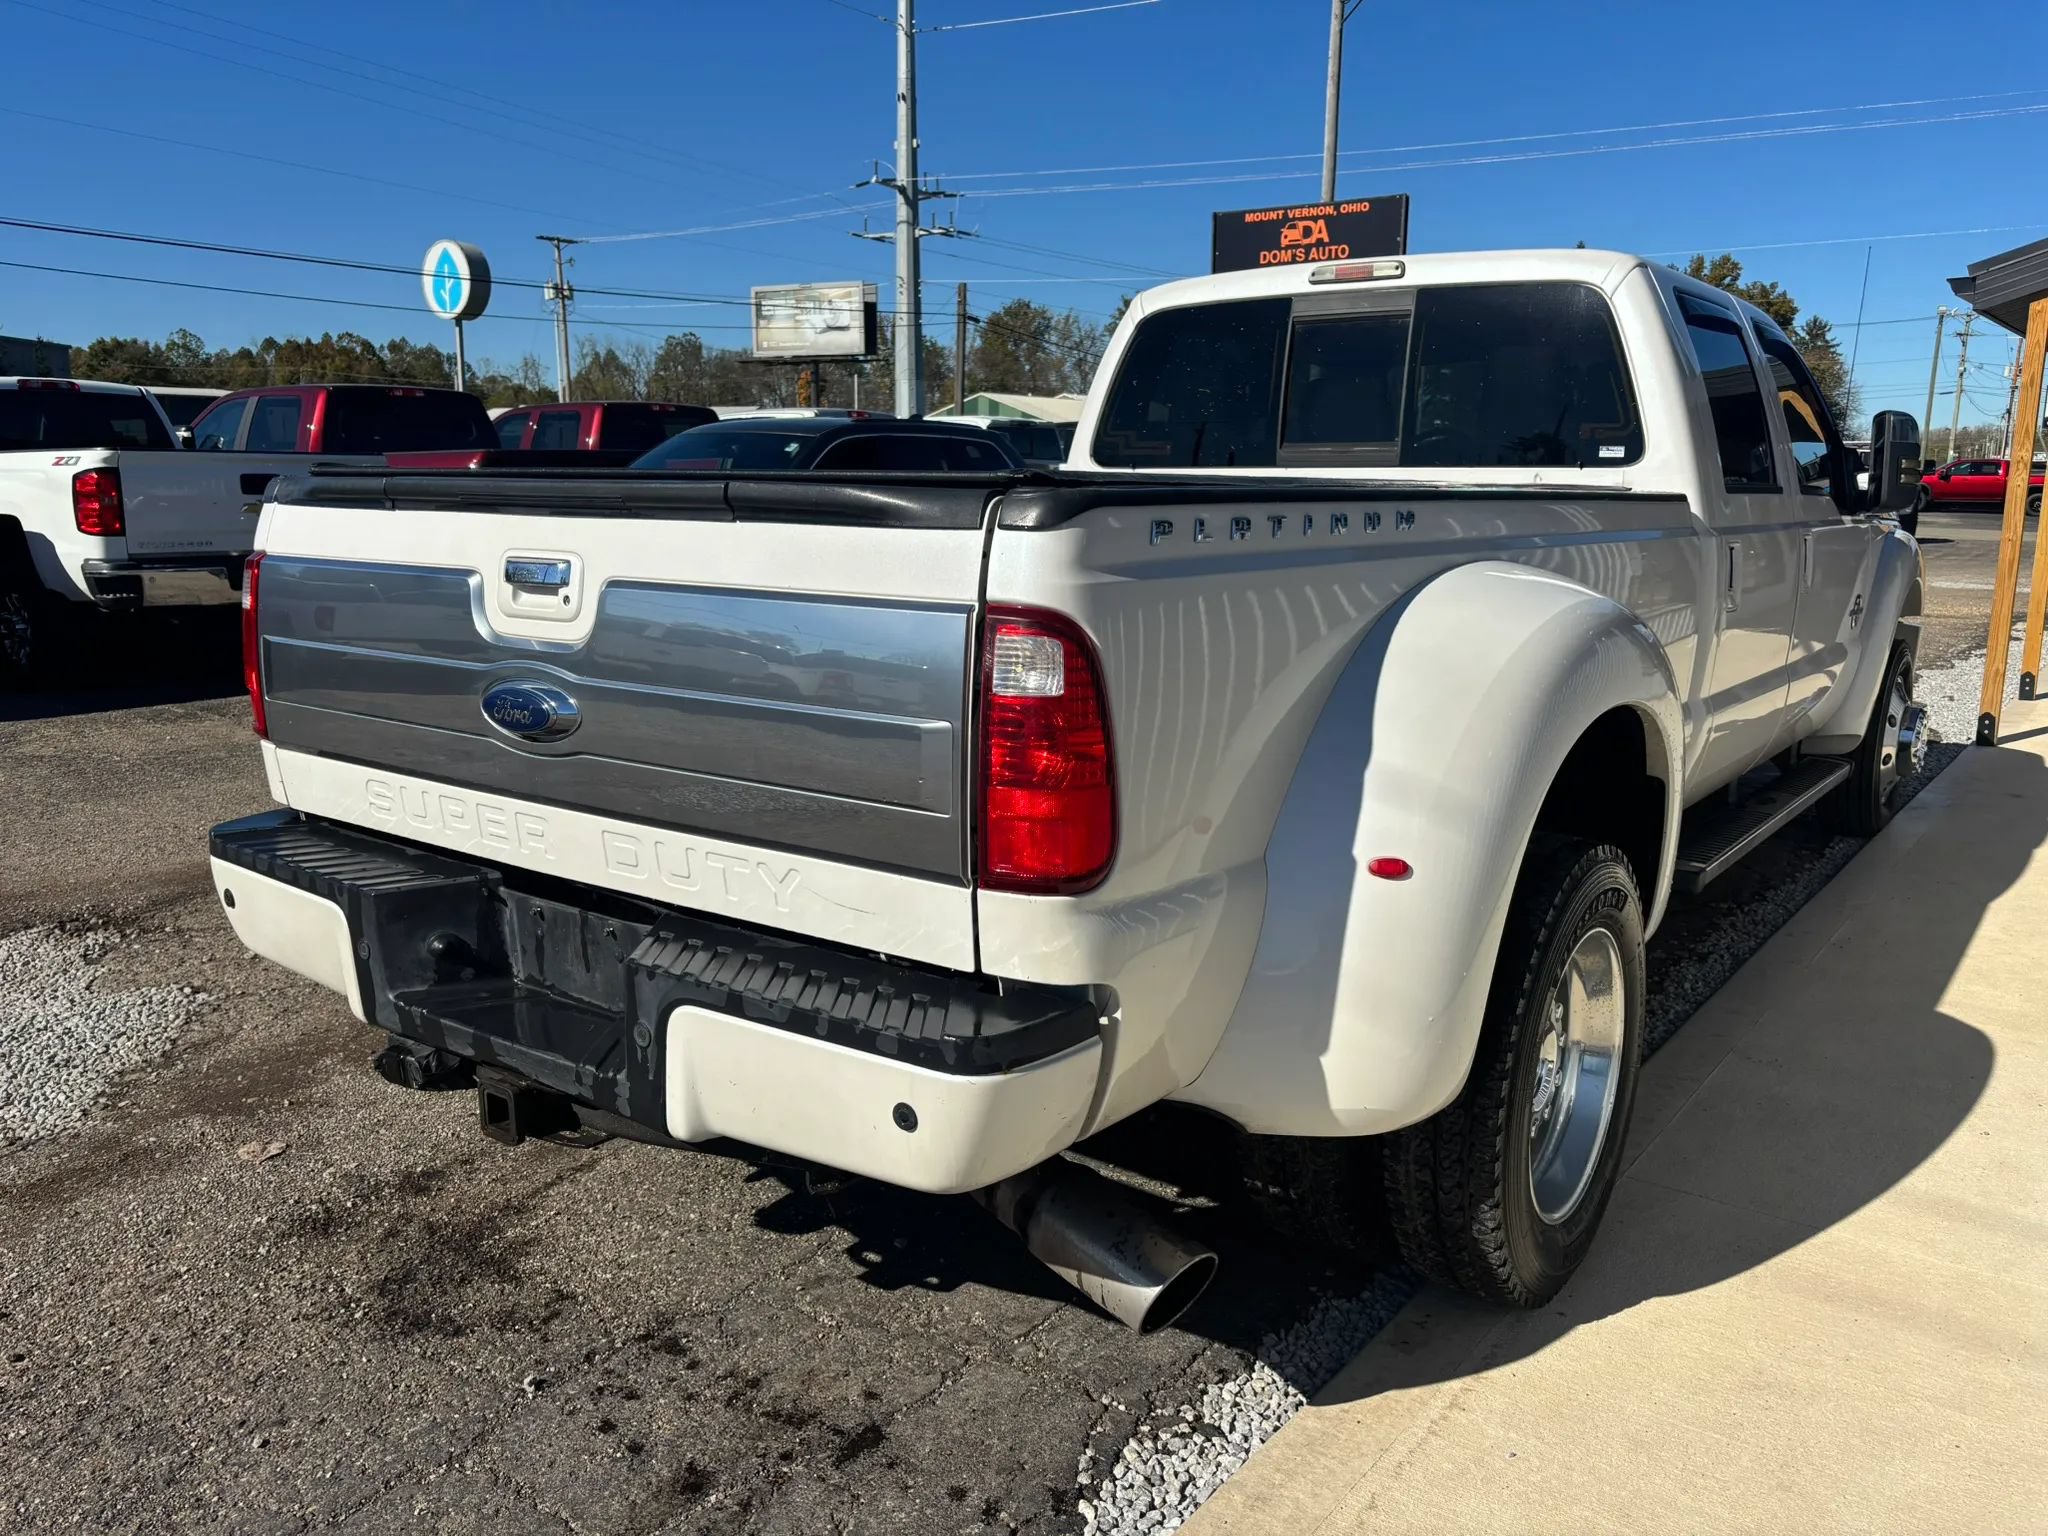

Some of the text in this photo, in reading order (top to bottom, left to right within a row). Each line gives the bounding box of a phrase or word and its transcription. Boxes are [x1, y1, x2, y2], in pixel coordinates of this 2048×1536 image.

[1245, 201, 1370, 223] MOUNT VERNON, OHIO
[1259, 244, 1349, 264] DOM'S AUTO
[1150, 510, 1415, 545] PLATINUM
[493, 694, 533, 725] Ford
[364, 779, 802, 912] SUPER DUTY
